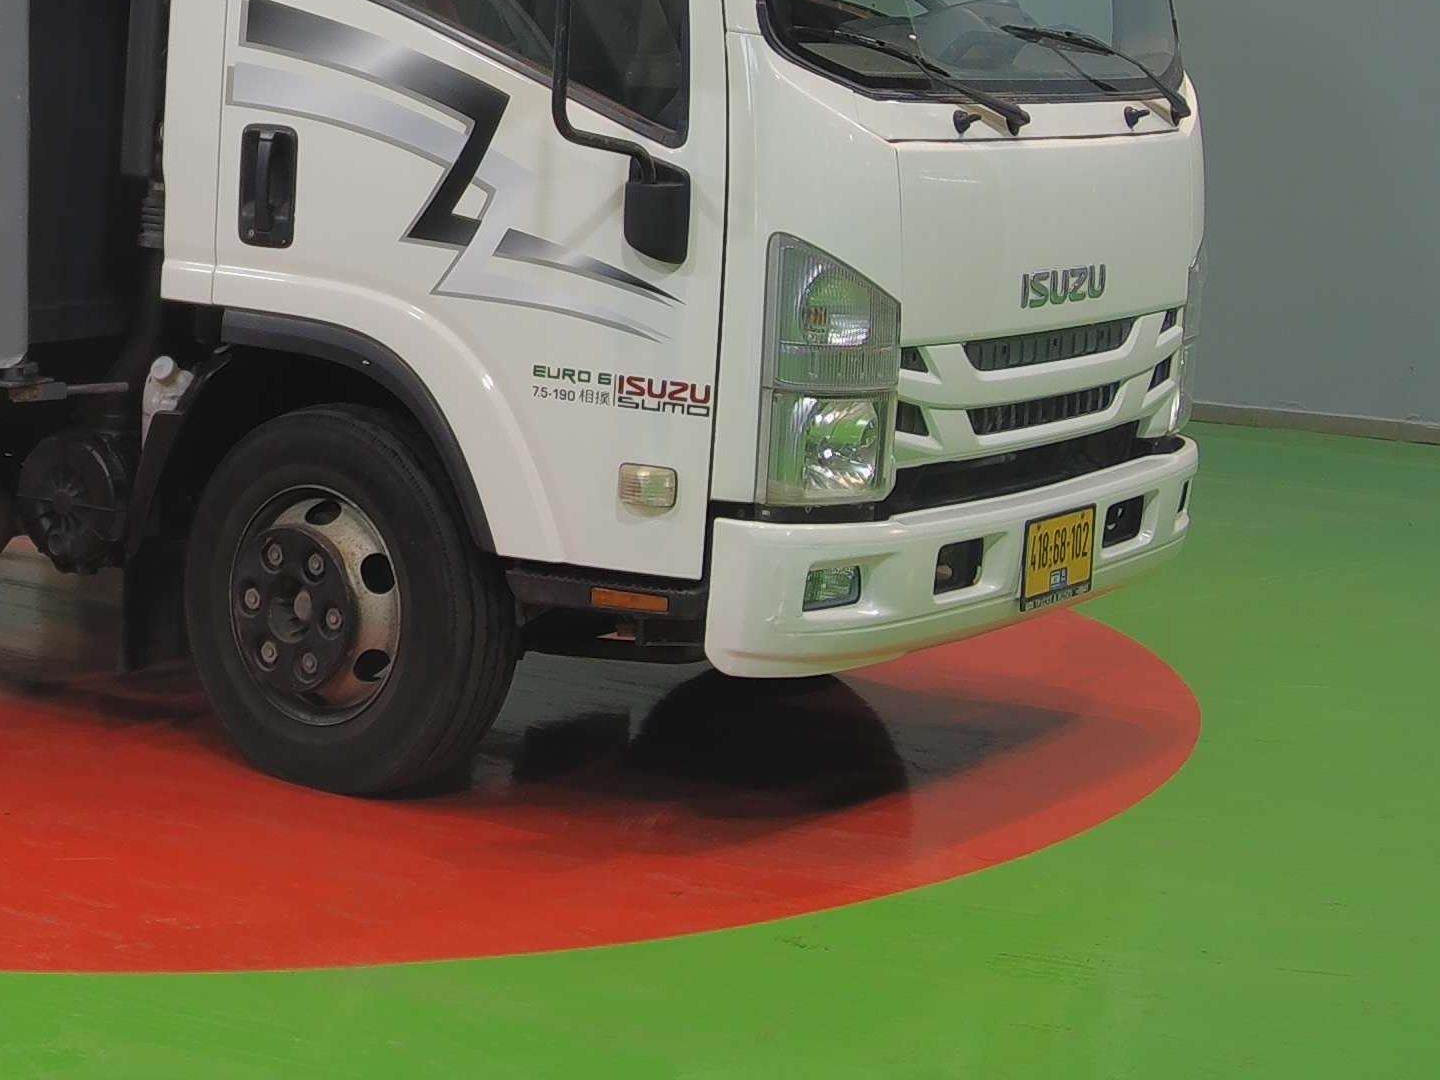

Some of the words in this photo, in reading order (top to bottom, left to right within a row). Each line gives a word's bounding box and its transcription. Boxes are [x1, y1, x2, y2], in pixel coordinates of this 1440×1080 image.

[1020, 263, 1106, 309] ISUZU
[532, 364, 591, 385] EURO
[597, 372, 612, 386] 6
[617, 374, 711, 405] ISUZU
[617, 396, 711, 418] SUMO
